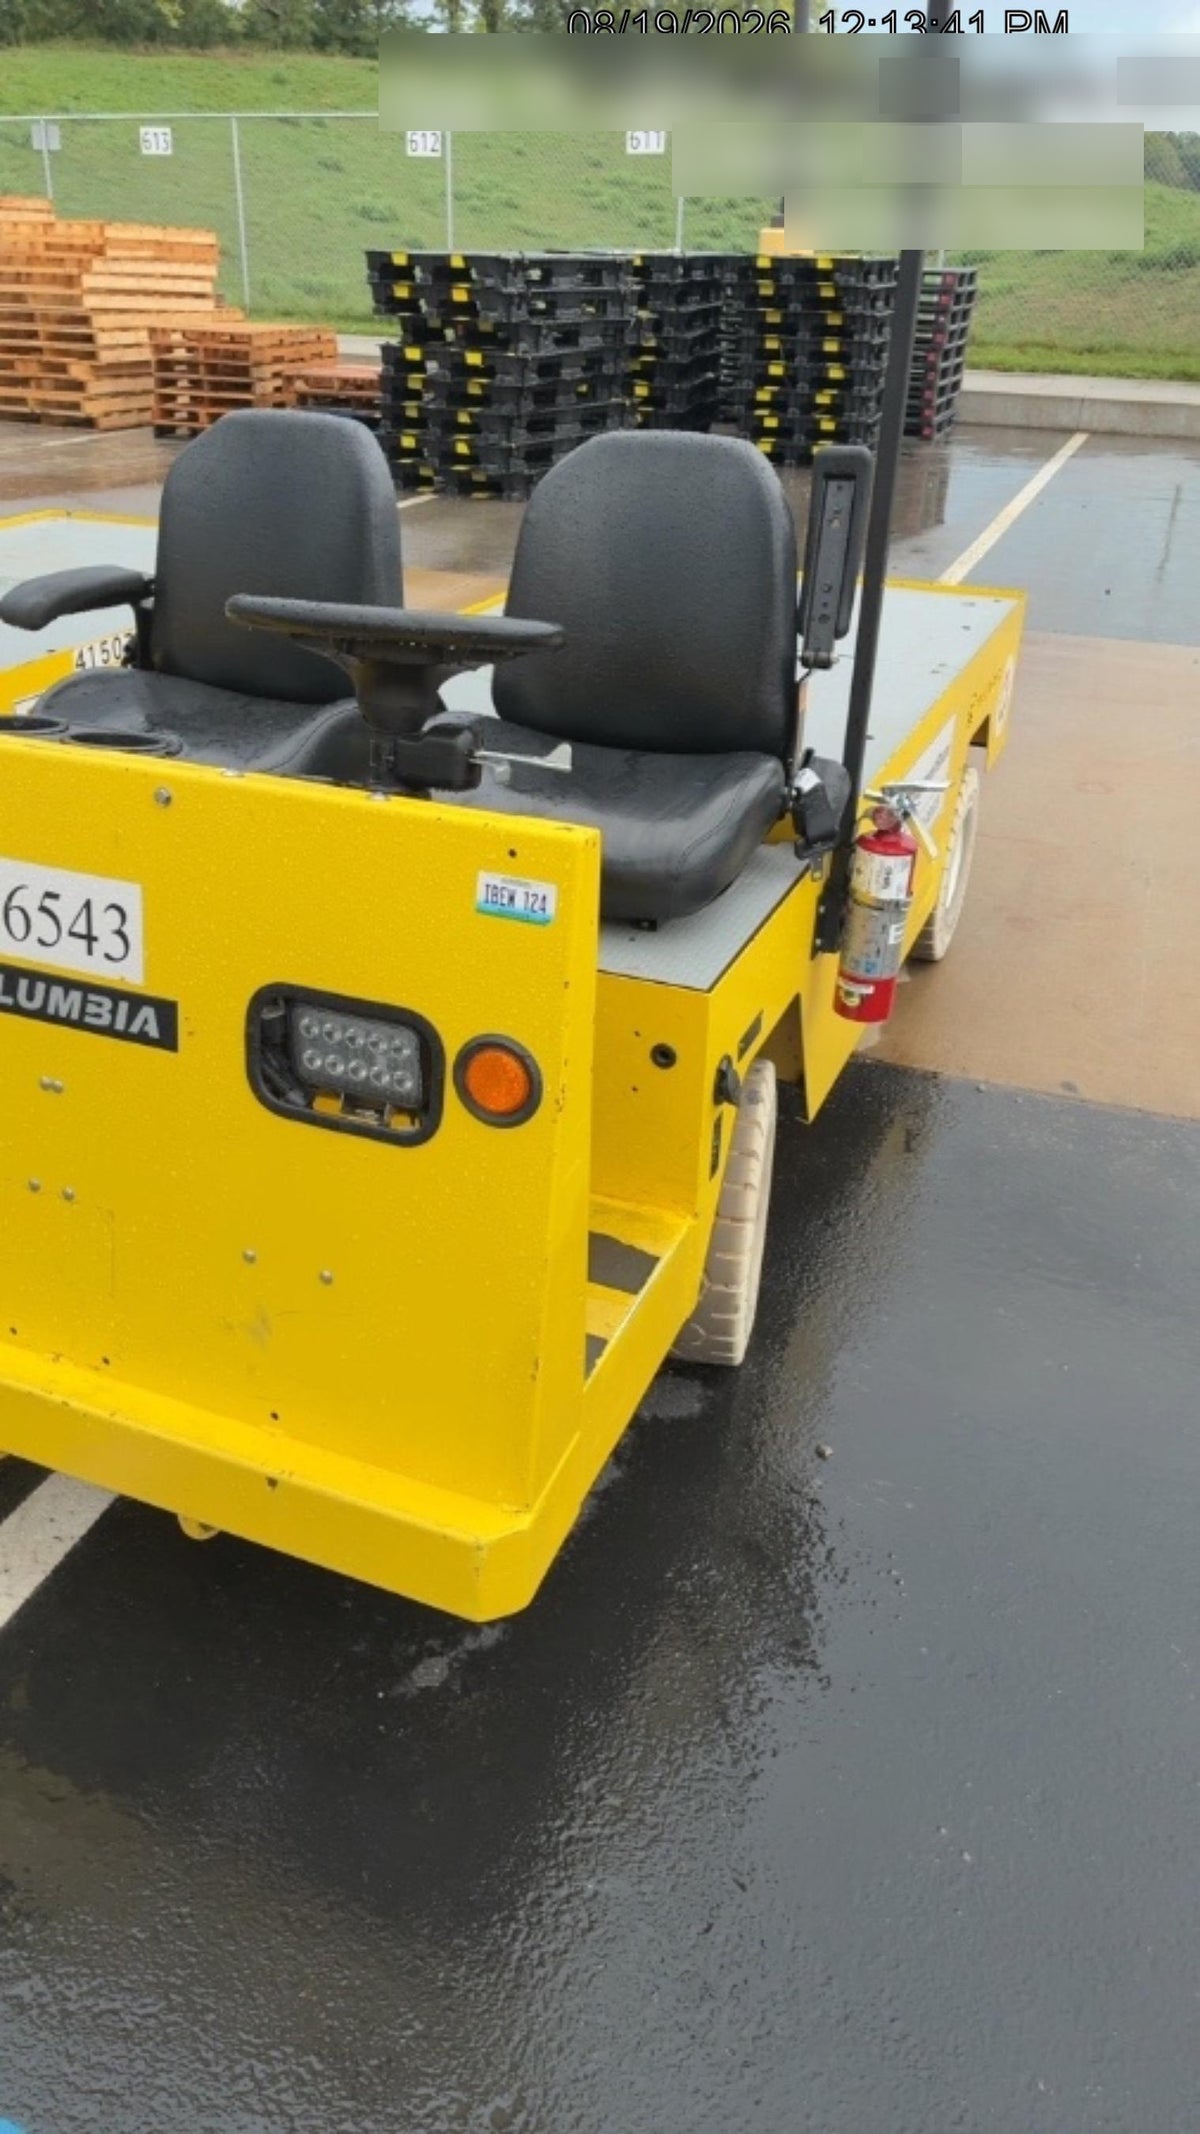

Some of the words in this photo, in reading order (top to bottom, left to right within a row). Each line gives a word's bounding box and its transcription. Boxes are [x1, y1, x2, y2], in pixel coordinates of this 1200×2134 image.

[141, 131, 170, 152] 613
[408, 131, 440, 153] 612
[75, 632, 132, 669] 4150
[524, 891, 546, 914] 124
[3, 884, 130, 962] 6543
